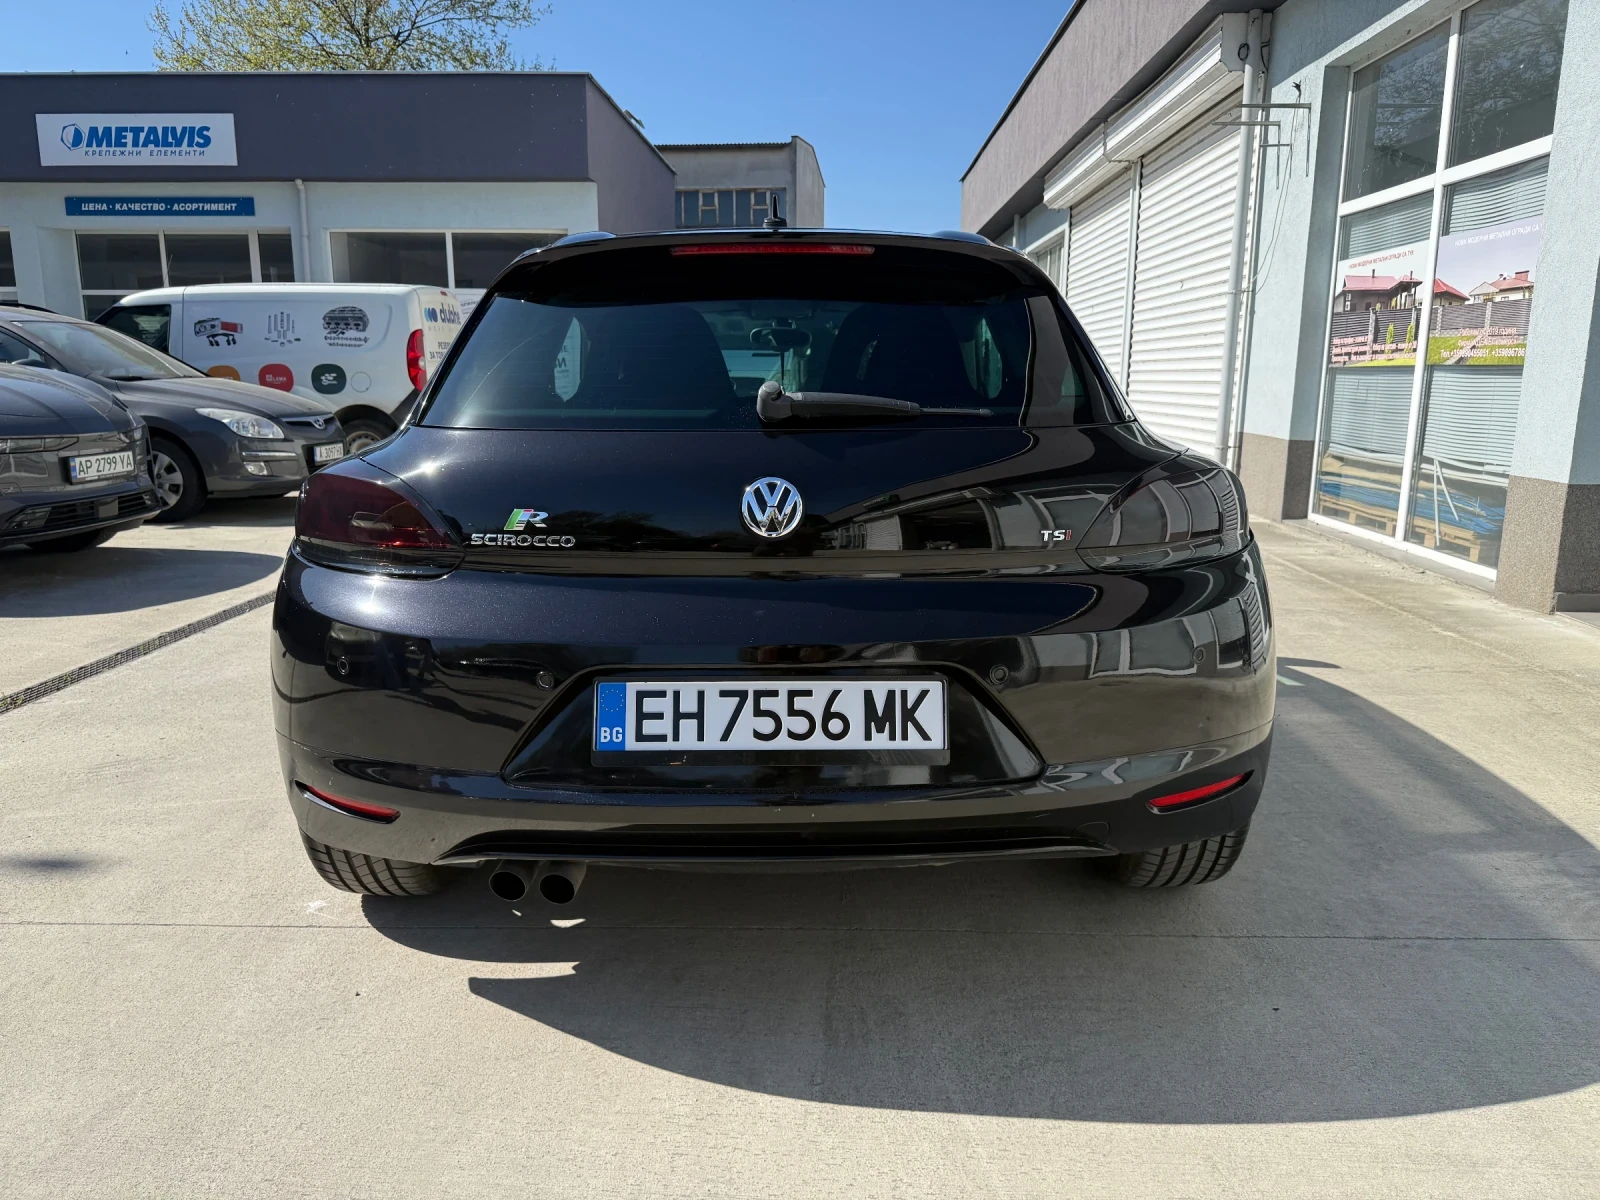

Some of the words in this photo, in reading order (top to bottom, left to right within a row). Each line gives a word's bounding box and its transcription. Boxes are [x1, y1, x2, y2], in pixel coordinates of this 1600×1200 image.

[86, 126, 212, 148] METALVIS
[81, 203, 108, 211] ЦЕНА
[115, 203, 166, 211] КАЧЕСТВО
[172, 203, 237, 211] АСОРТИМЕНТ
[1511, 225, 1531, 236] ОГРАДИ
[1531, 224, 1540, 232] СА
[78, 459, 93, 476] AP
[95, 456, 117, 473] 2799
[119, 454, 133, 469] YA
[470, 533, 576, 547] SCIROCCO
[1041, 529, 1072, 541] TSI
[600, 727, 623, 743] BG
[635, 689, 705, 743] EH
[719, 689, 851, 742] 7556
[864, 689, 933, 742] MK
